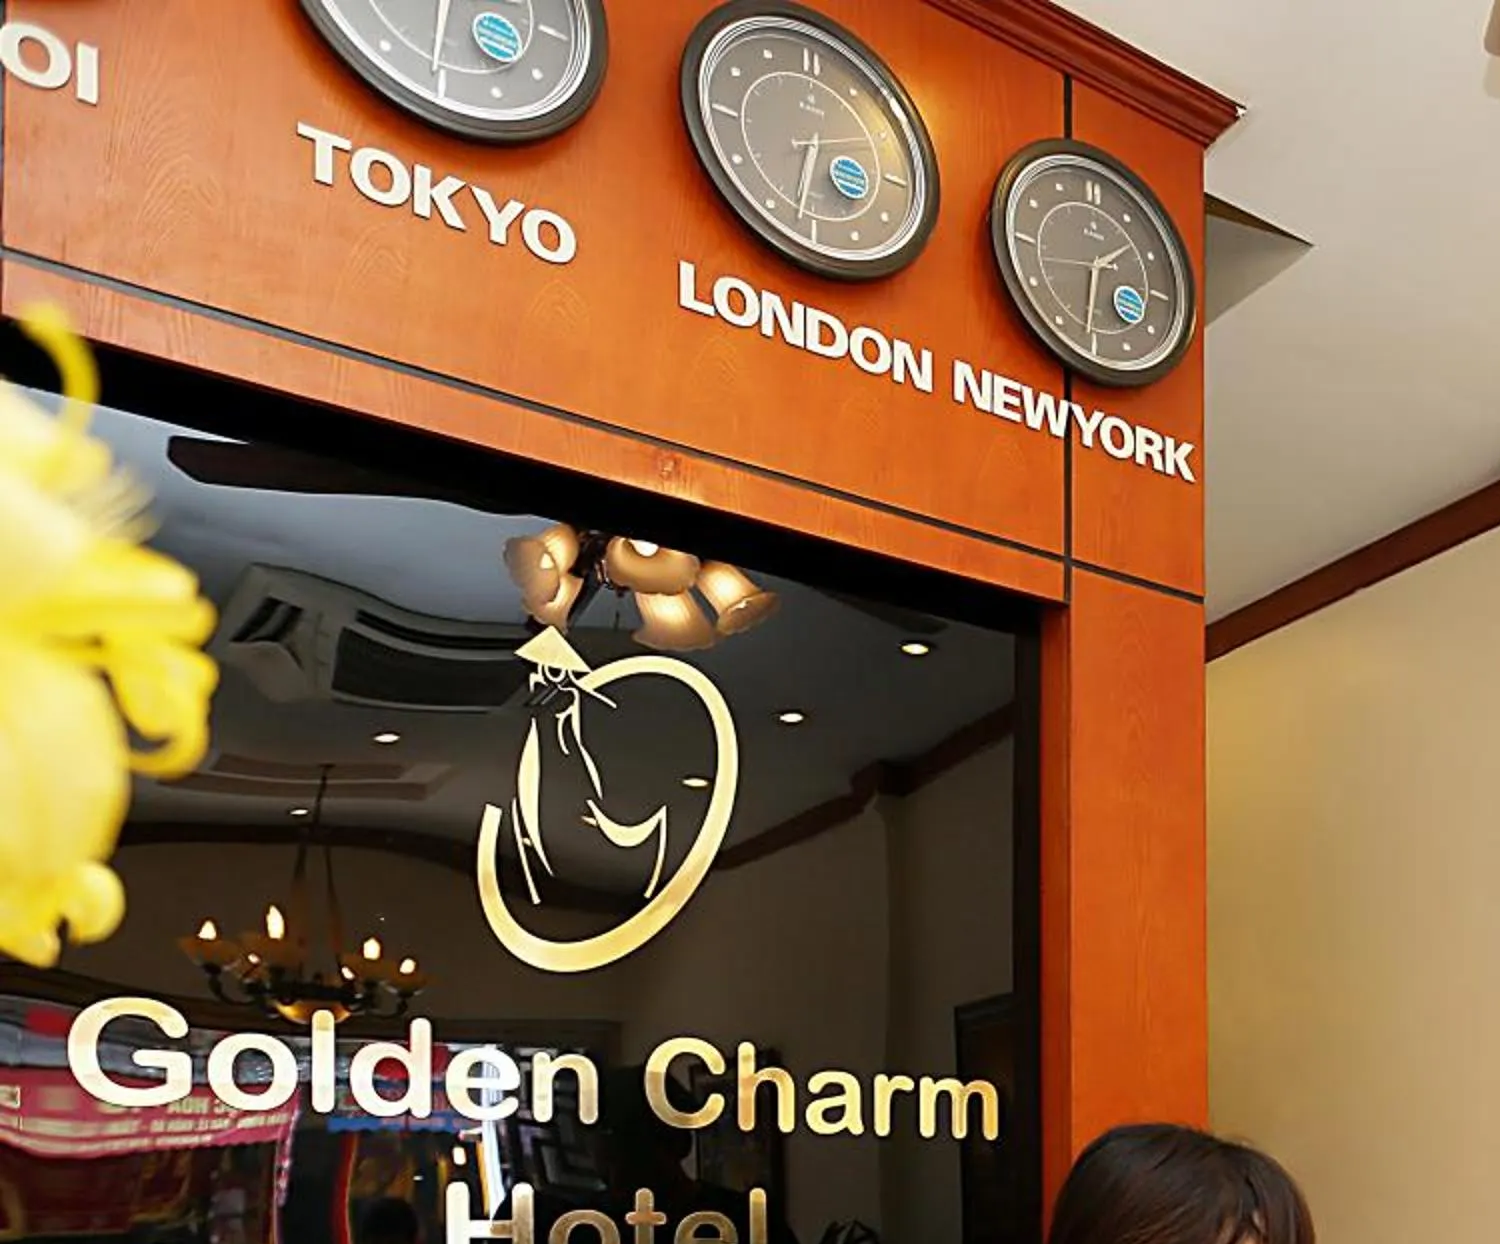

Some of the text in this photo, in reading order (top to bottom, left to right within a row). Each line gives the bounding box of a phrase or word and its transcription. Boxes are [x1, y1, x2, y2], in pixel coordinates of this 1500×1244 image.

[297, 121, 577, 264] TOKYO
[679, 261, 933, 393] LONDON
[954, 360, 1195, 482] NEWYORK
[67, 996, 1000, 1141] Golden Charm
